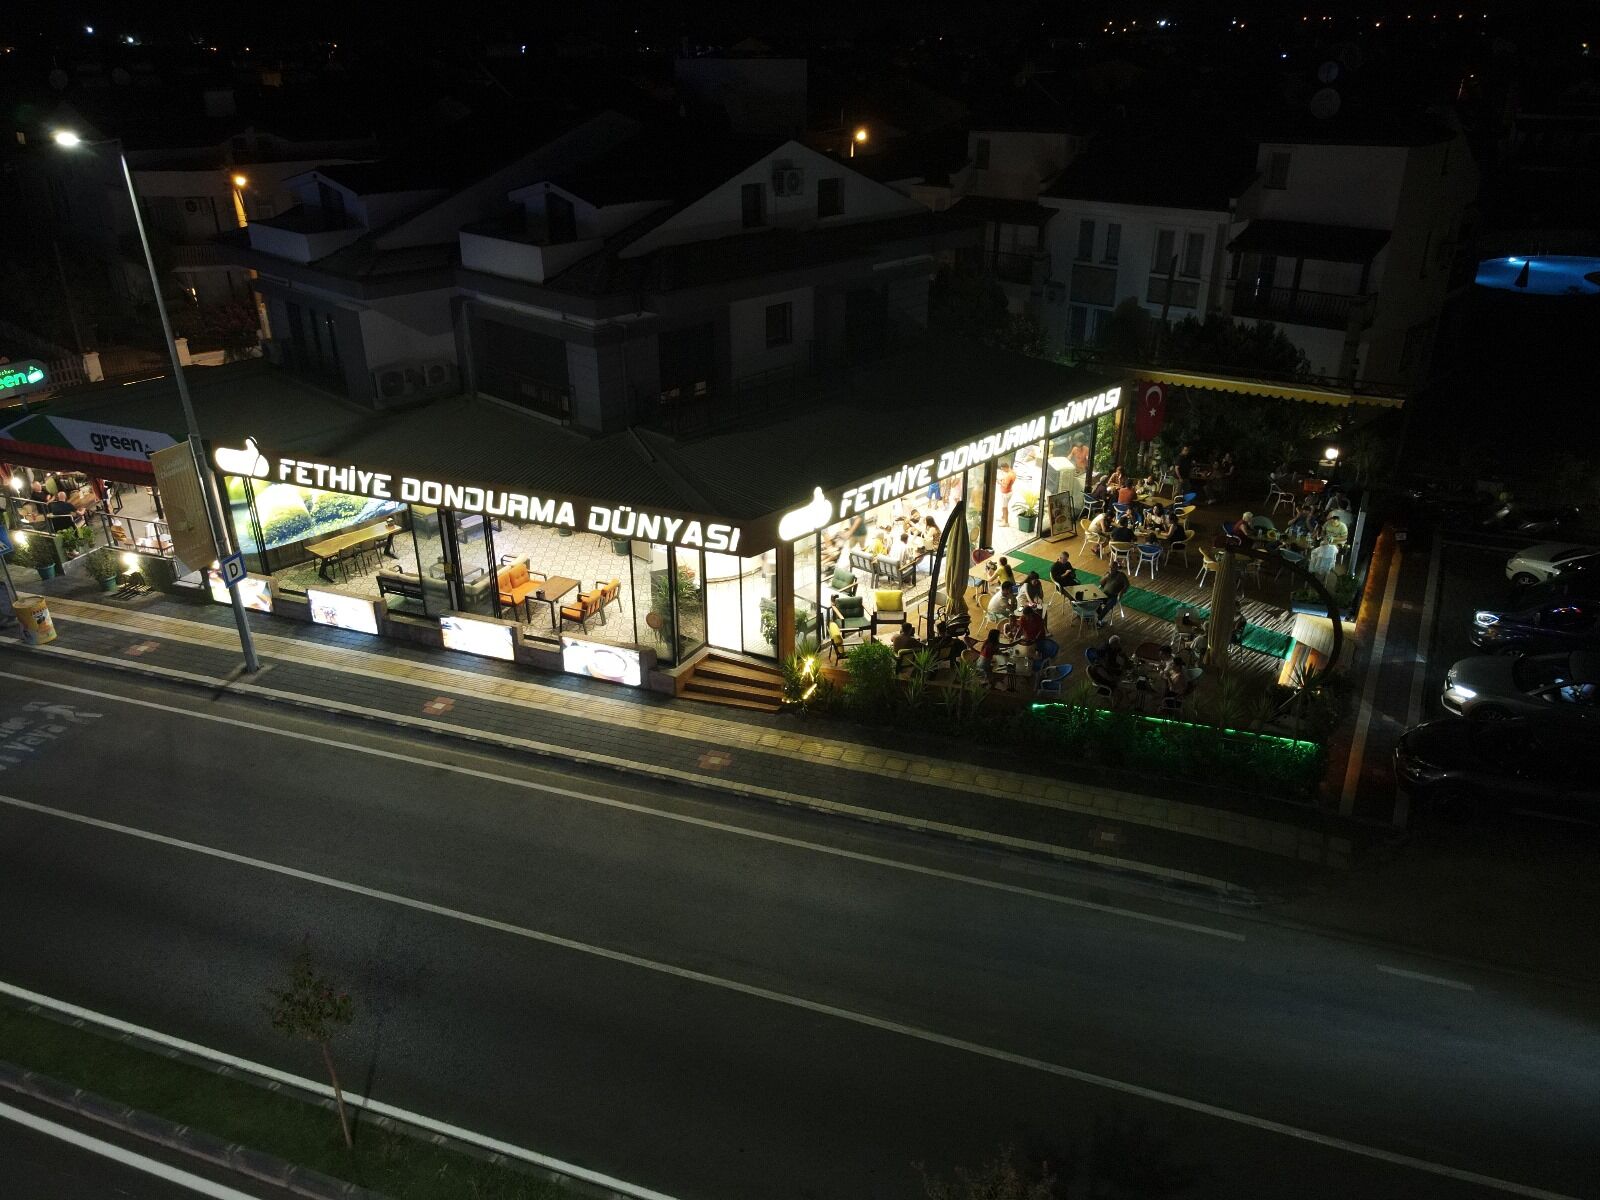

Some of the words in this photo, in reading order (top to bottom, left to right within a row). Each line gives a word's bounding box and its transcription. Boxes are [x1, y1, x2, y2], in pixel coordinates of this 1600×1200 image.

[90, 431, 143, 453] green
[839, 459, 935, 518] FETHİYE
[937, 416, 1045, 478] DONDURMA
[1049, 387, 1121, 433] DÜNYASI
[279, 458, 391, 498] FETHİYE
[401, 477, 575, 527] DONDURMA
[588, 506, 741, 552] DÜNYASI
[229, 562, 238, 578] D
